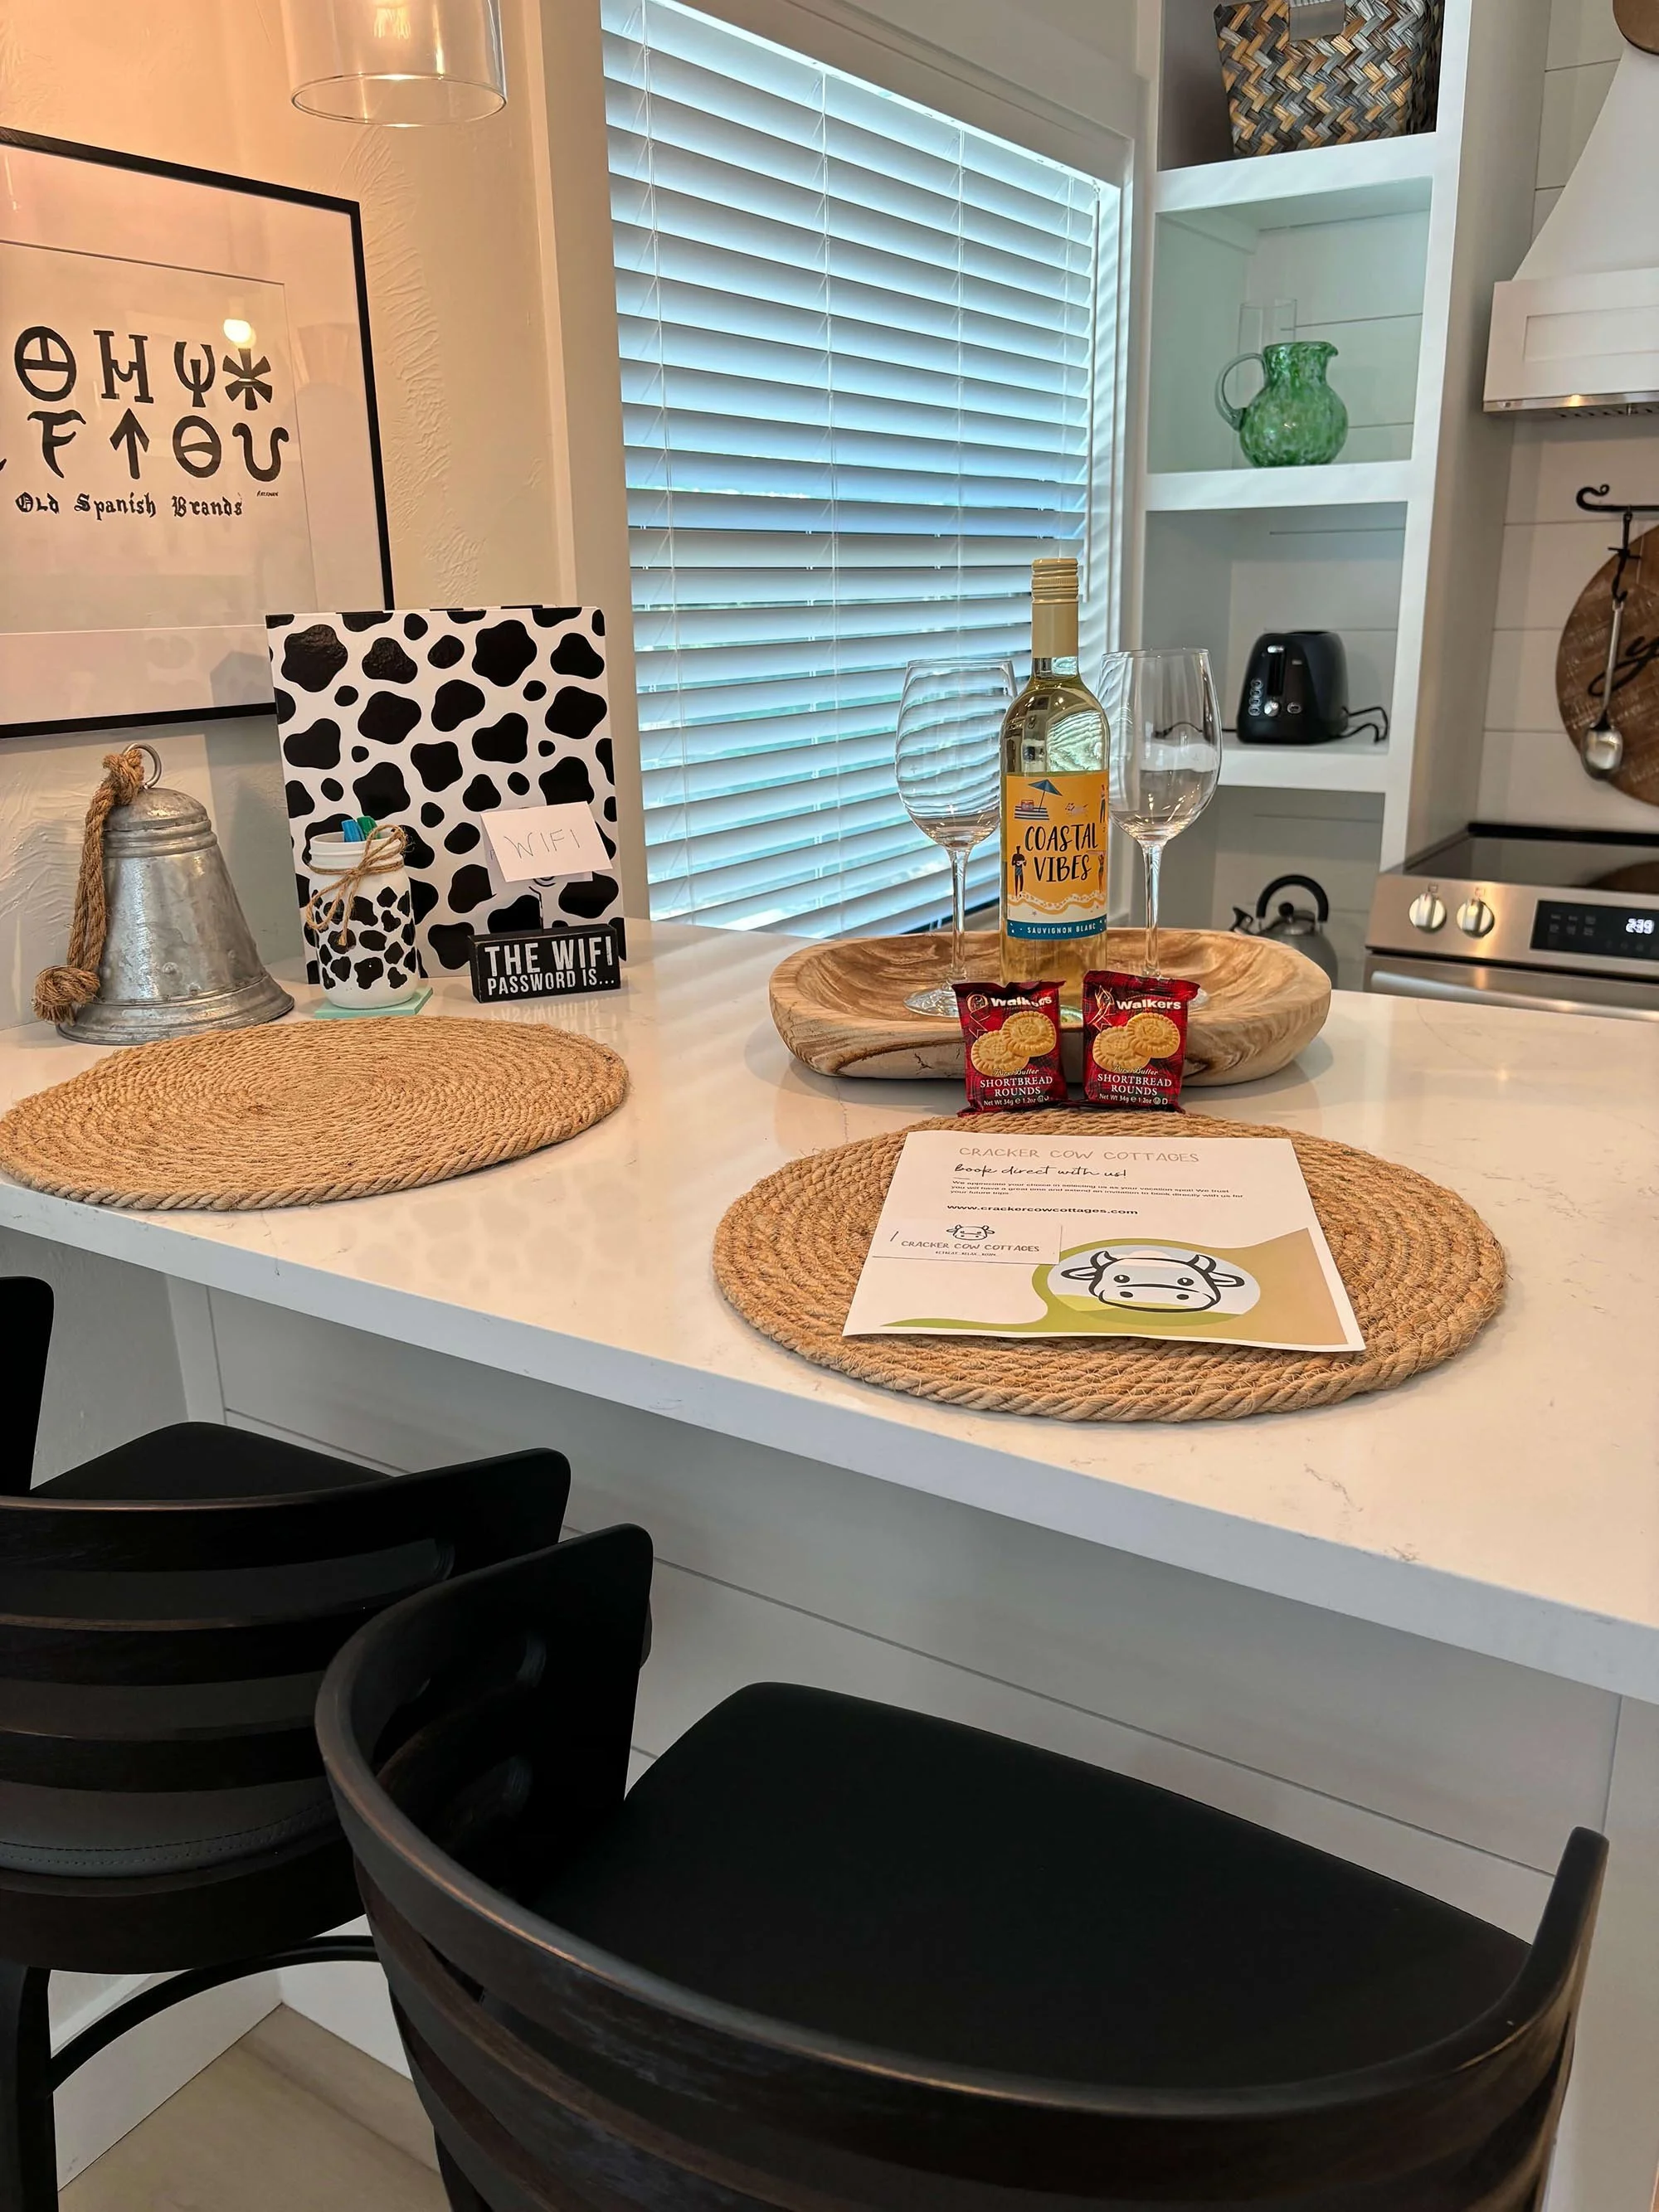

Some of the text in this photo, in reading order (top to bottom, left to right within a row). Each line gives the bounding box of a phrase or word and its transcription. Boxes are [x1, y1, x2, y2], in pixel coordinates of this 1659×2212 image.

[74, 492, 157, 520] Spanish
[171, 494, 243, 517] Brands
[1024, 822, 1099, 852] COASTAL
[504, 829, 581, 859] WIFI
[1034, 853, 1092, 882] VIBES
[1027, 922, 1096, 935] SAUVIGNON BLANC
[484, 936, 613, 977] THE WIFI
[487, 968, 615, 996] PASSWORD IS...
[1116, 999, 1182, 1010] Walkers
[1014, 1067, 1039, 1077] Butter
[1133, 1066, 1159, 1076] Butter
[980, 1076, 1053, 1088] SHORTBREAD
[1097, 1073, 1172, 1087] SHORTBREAD
[995, 1086, 1041, 1097] ROUNDS
[1111, 1084, 1158, 1096] ROUNDS
[1119, 1095, 1129, 1103] 34g
[959, 1147, 1199, 1163] CRACKER COW COTTAGES
[1001, 1164, 1058, 1175] direct
[1058, 1166, 1100, 1176] with
[1104, 1169, 1126, 1179] us!
[946, 1205, 1139, 1215] www.crackercowcottages.com
[901, 1240, 949, 1249] CRACKER
[984, 1244, 1040, 1252] COTTAGES
